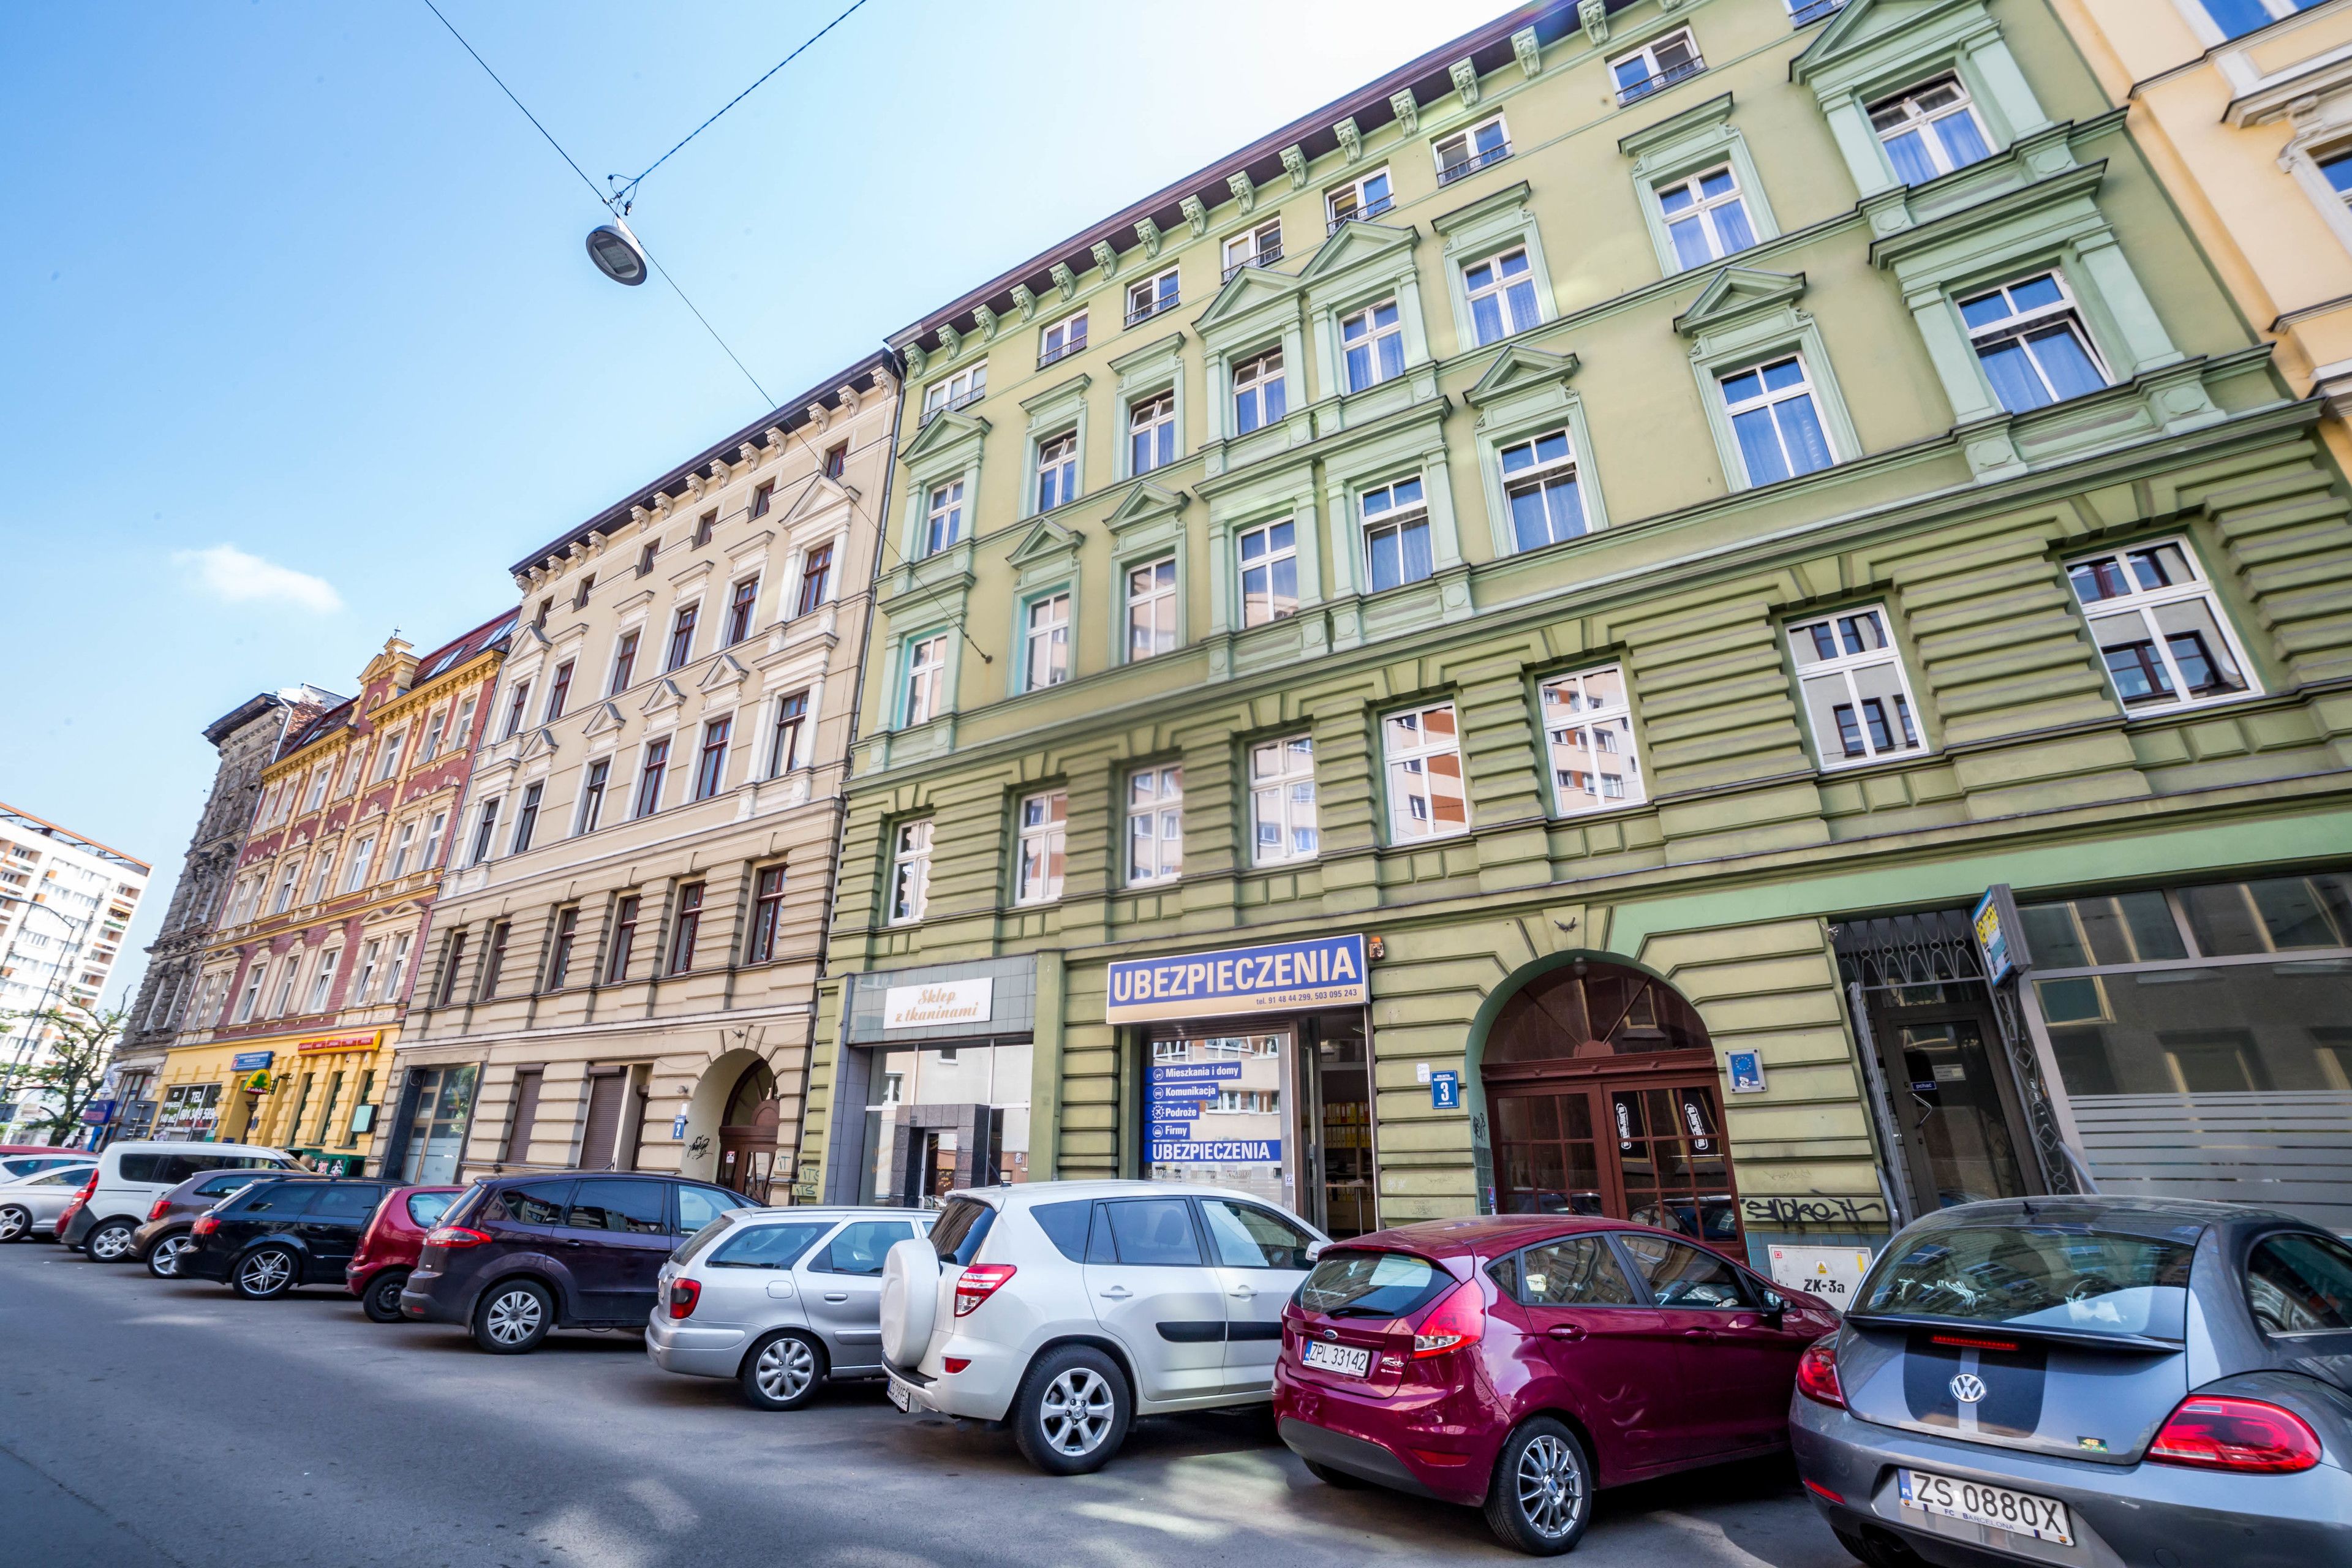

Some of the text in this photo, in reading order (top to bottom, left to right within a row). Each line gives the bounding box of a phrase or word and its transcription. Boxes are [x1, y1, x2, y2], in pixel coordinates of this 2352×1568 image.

[1114, 947, 1357, 1002] UBEZPIECZENIA
[918, 987, 957, 1005] Sklep
[895, 1002, 979, 1022] z tkaninami
[1165, 1066, 1238, 1077] Mieszkania i domy
[1165, 1085, 1216, 1098] Komunikacja
[1440, 1082, 1449, 1101] 3
[676, 1124, 681, 1136] 2
[1165, 1125, 1187, 1136] Firmy
[1152, 1142, 1271, 1160] UBEZPIECZENIA
[1803, 1278, 1845, 1294] ZK-3a
[1310, 1344, 1327, 1363] ZPL
[1331, 1348, 1366, 1371] 33142
[1902, 1488, 1911, 1497] PL
[1914, 1474, 2062, 1534] ZS 0880X
[1962, 1513, 2015, 1531] BARCELONA
